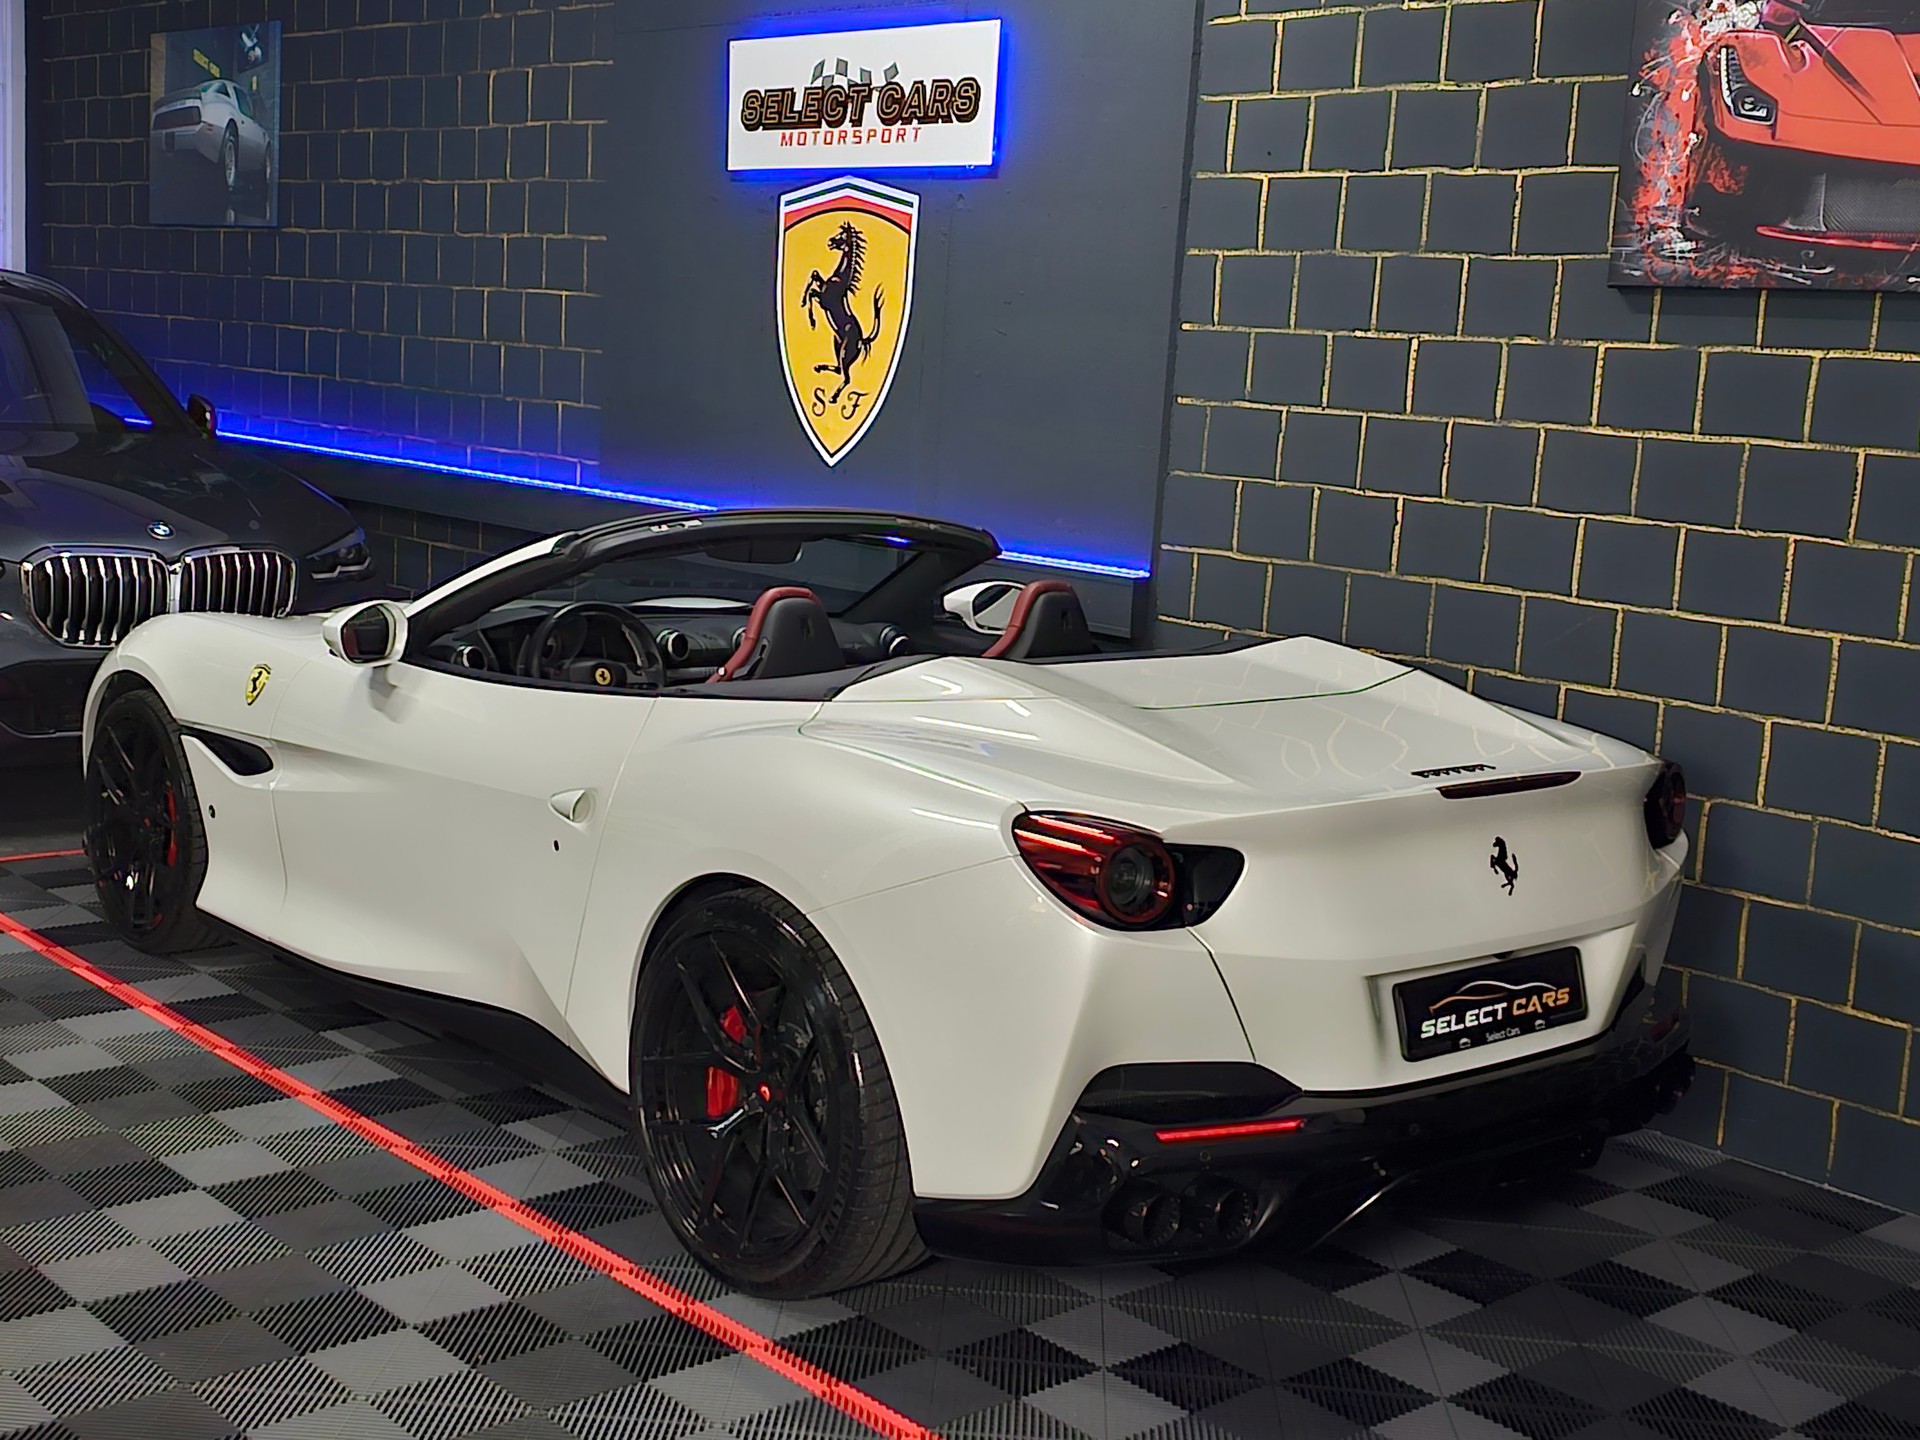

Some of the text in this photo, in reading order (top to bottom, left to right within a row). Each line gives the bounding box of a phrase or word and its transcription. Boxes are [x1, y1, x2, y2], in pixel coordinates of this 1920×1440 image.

[741, 76, 982, 131] SELECT CARS
[780, 126, 922, 147] MOTORSPORT
[811, 387, 868, 420] S F
[1420, 987, 1570, 1039] SELECT CARS
